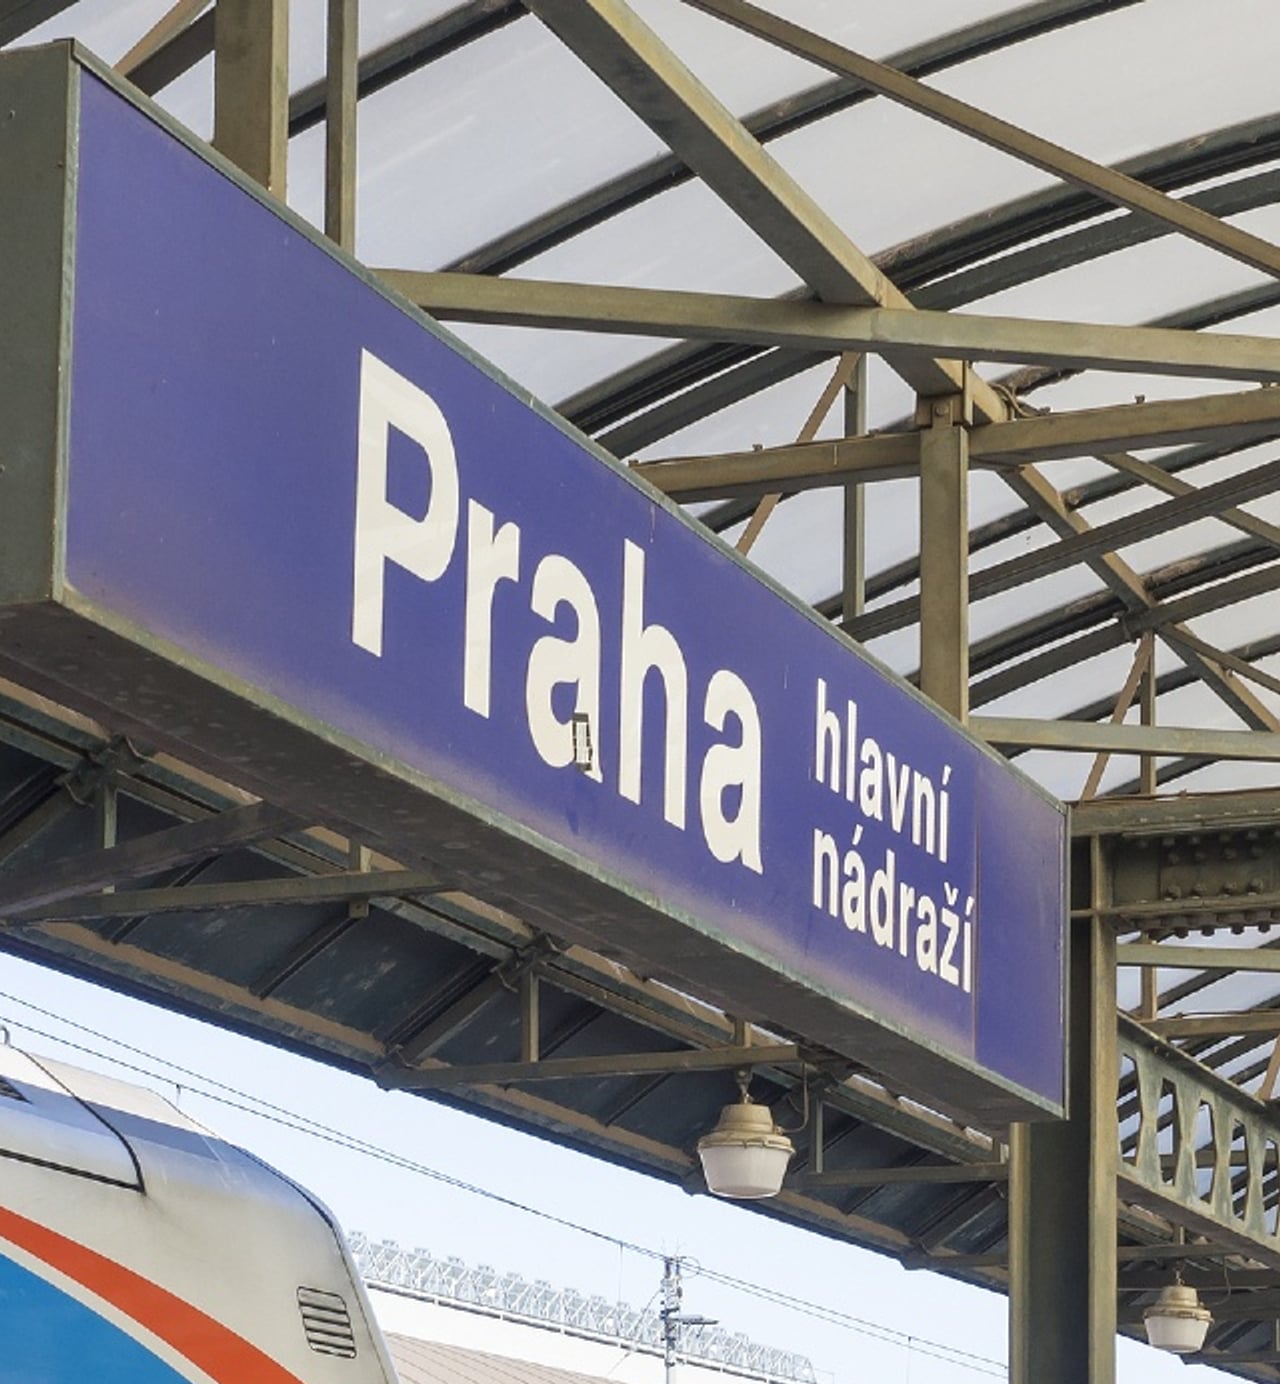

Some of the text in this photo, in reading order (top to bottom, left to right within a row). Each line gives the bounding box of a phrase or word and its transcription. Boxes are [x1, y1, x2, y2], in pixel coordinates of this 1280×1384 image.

[351, 346, 763, 875] Praha
[815, 677, 952, 863] hlavní
[812, 824, 975, 993] nádraží
